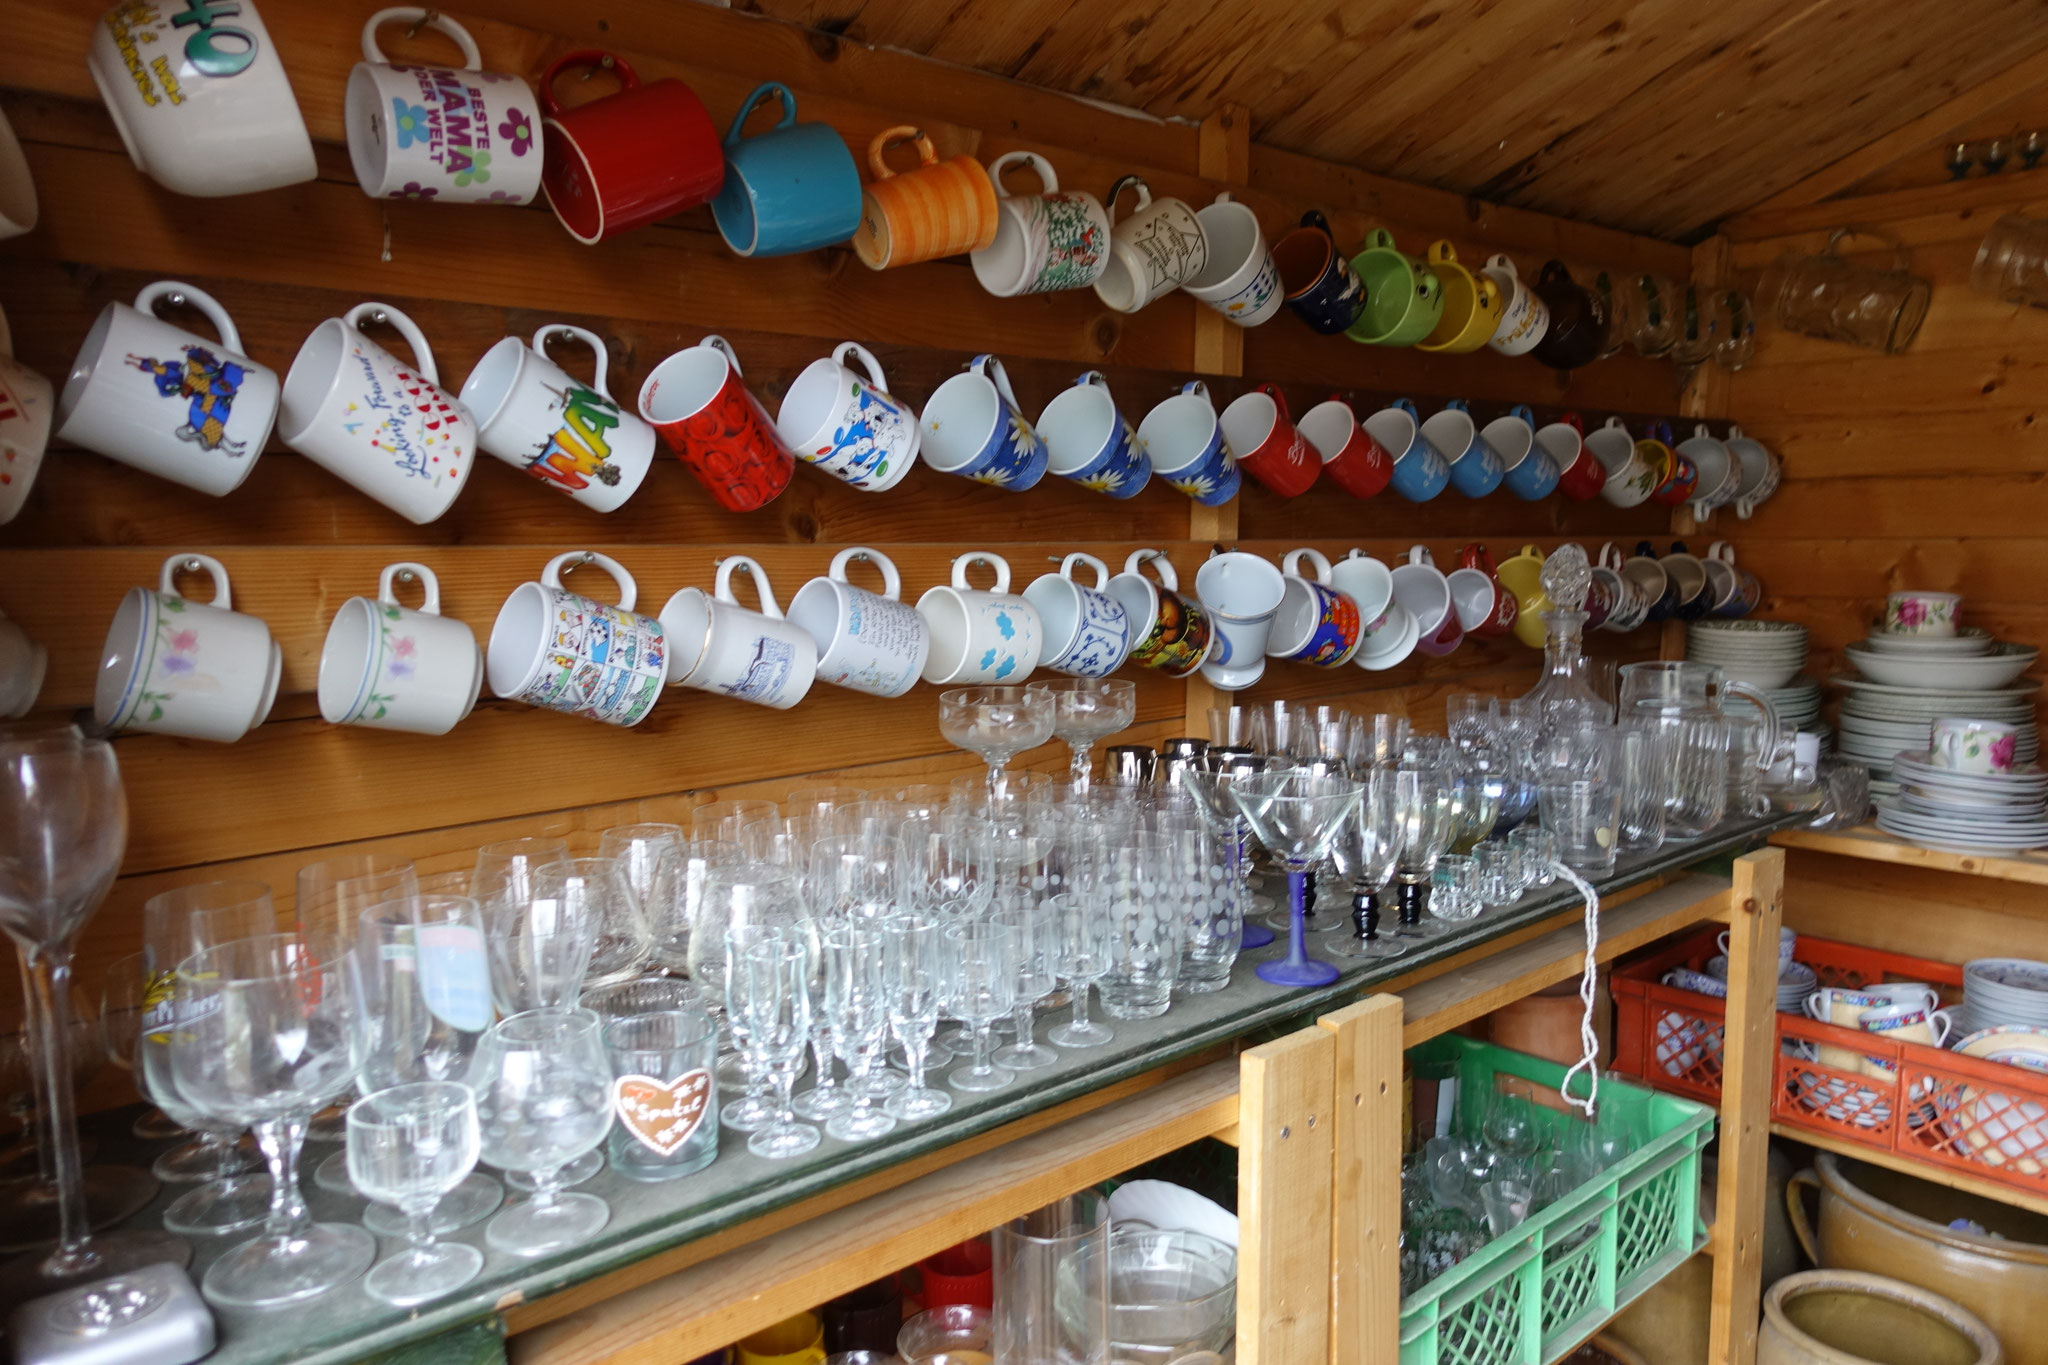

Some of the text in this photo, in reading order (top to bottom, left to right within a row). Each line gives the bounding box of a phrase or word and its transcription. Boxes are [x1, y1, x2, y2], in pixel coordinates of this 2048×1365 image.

[414, 71, 445, 165] DER WELT
[429, 69, 474, 175] MAMA
[466, 87, 491, 150] BESTE
[352, 354, 432, 480] Looking Forward
